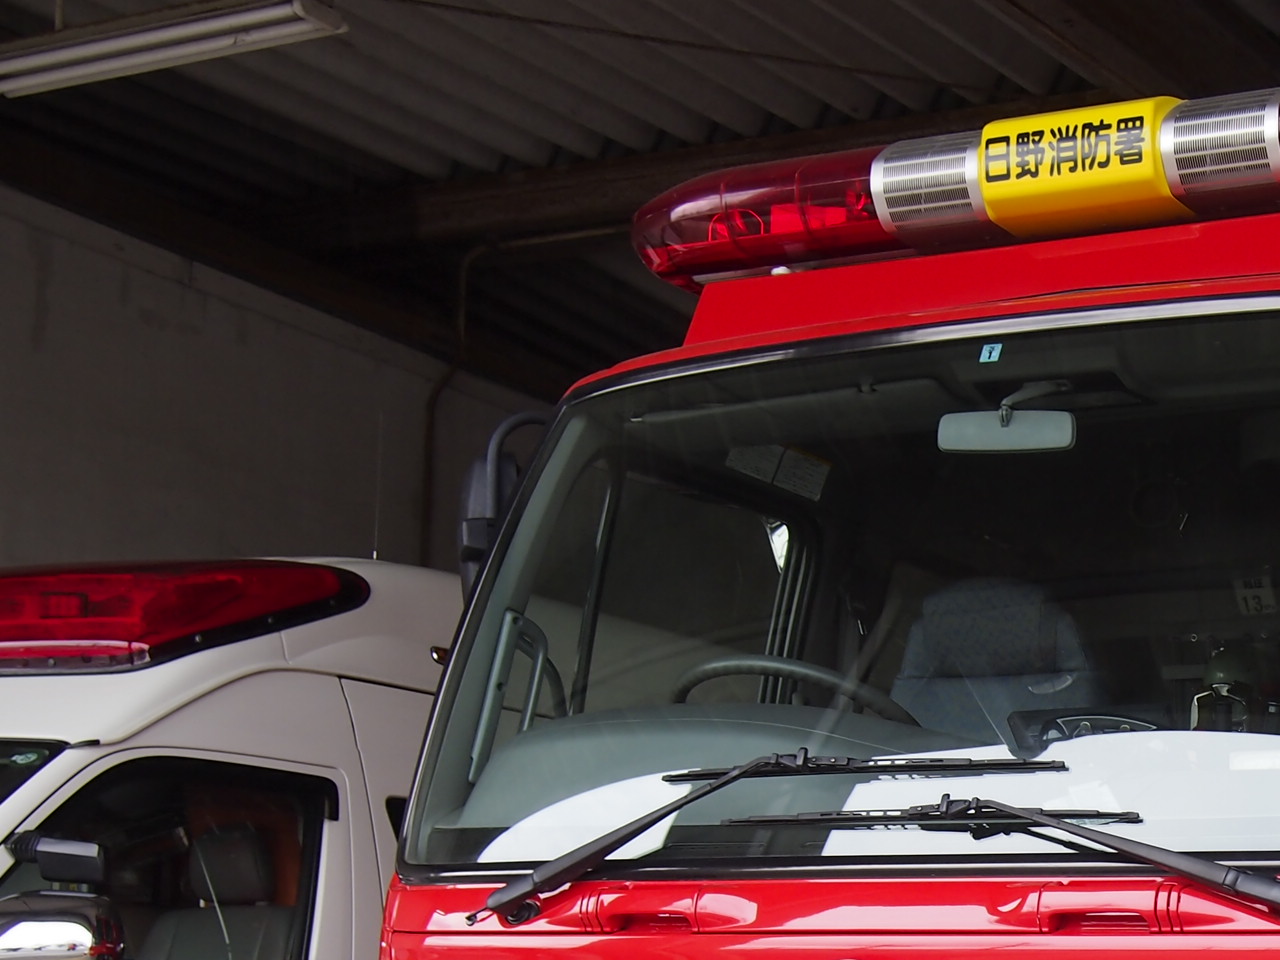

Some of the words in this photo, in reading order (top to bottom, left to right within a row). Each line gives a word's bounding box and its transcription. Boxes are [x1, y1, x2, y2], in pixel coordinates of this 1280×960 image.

[984, 115, 1146, 183] 日野消防署
